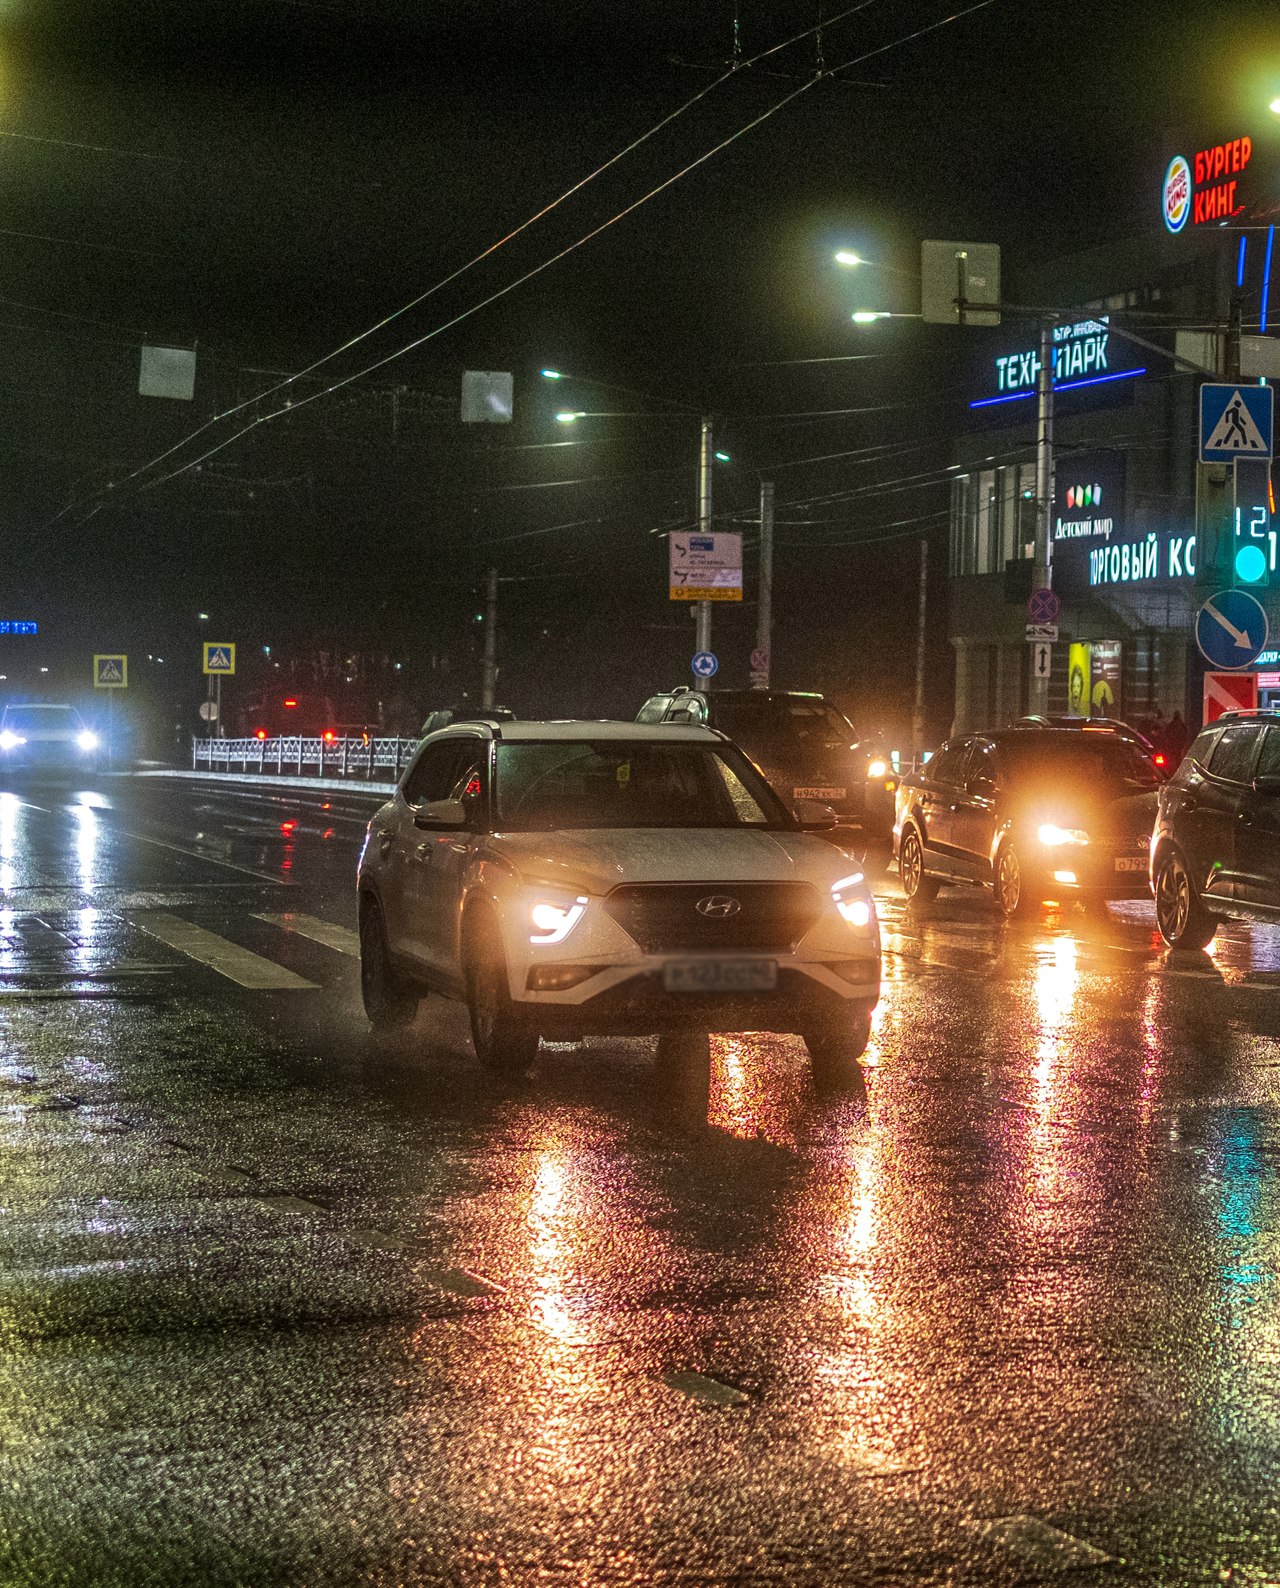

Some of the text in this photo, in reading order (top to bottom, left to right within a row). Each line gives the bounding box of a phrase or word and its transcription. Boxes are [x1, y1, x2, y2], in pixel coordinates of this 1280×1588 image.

[1195, 136, 1252, 184] БУРГЕР
[1194, 180, 1236, 224] КИНГ
[996, 334, 1109, 390] ТЕХНПАРК
[1055, 516, 1113, 540] Детский мир
[1235, 506, 1266, 538] 12
[1090, 533, 1157, 586] ТОРГОВЫЙ
